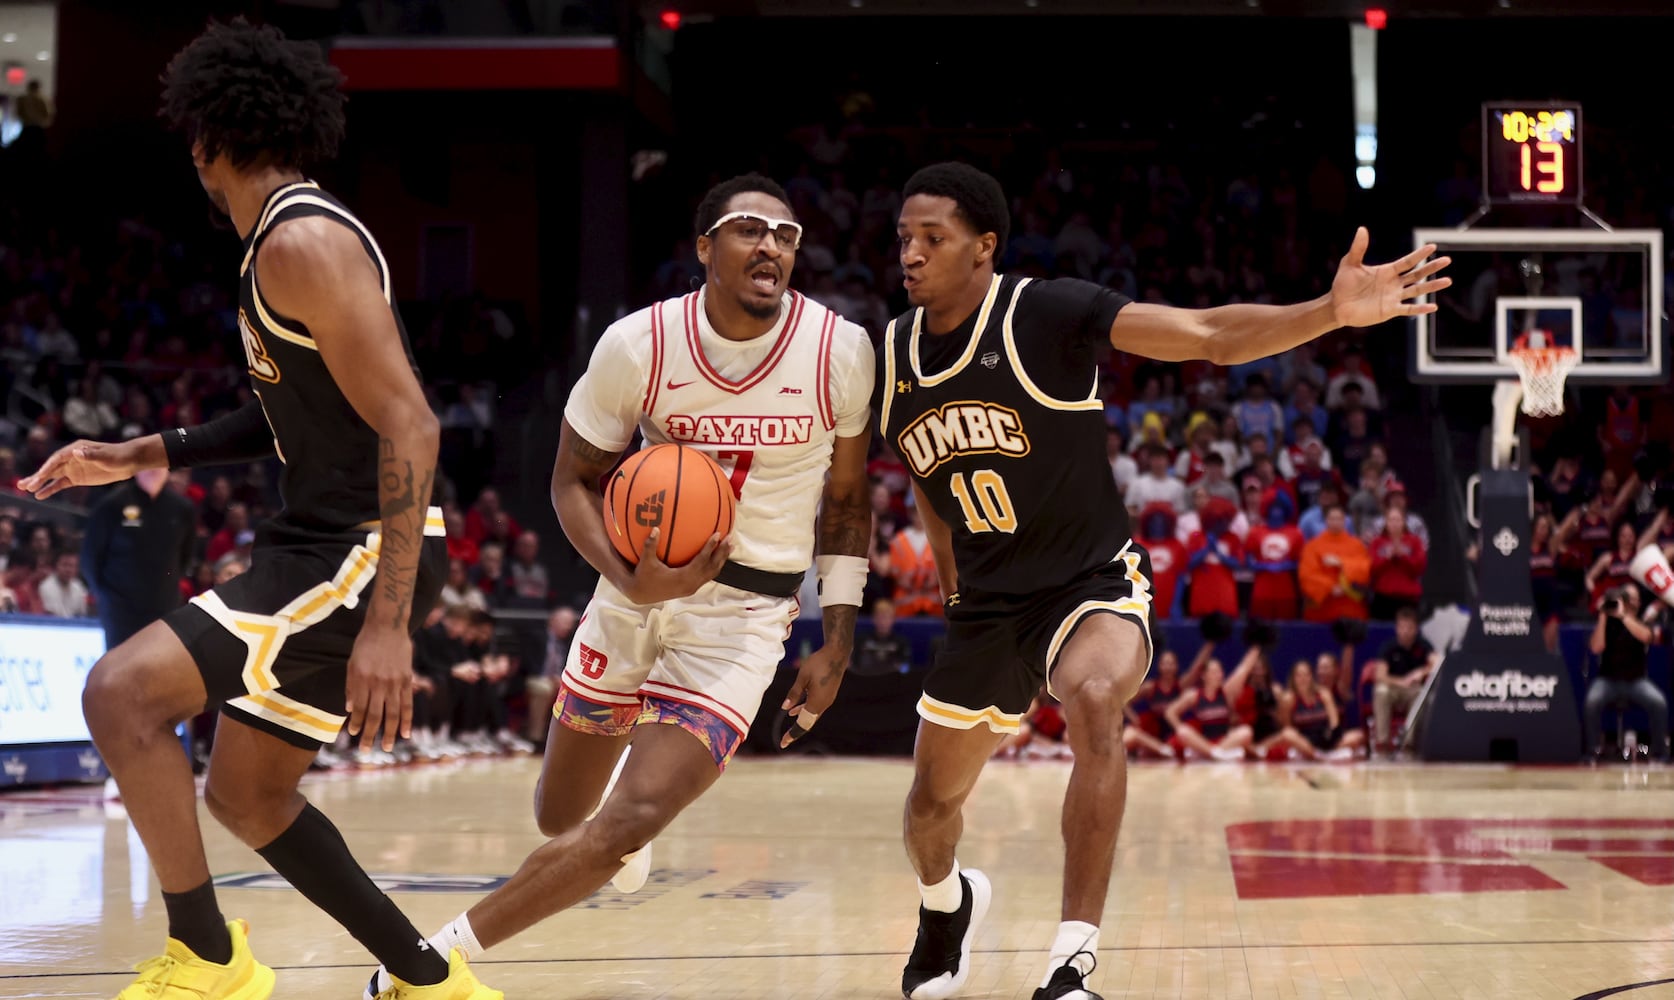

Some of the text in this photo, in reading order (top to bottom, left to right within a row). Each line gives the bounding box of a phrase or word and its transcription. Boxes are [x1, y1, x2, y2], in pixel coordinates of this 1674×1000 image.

[1520, 142, 1564, 193] 13
[665, 414, 814, 446] DAYTON
[898, 400, 1031, 478] UMBC
[950, 469, 1018, 535] 10
[1479, 604, 1533, 621] Premier
[1482, 621, 1530, 636] Health
[1454, 670, 1559, 702] altafiber
